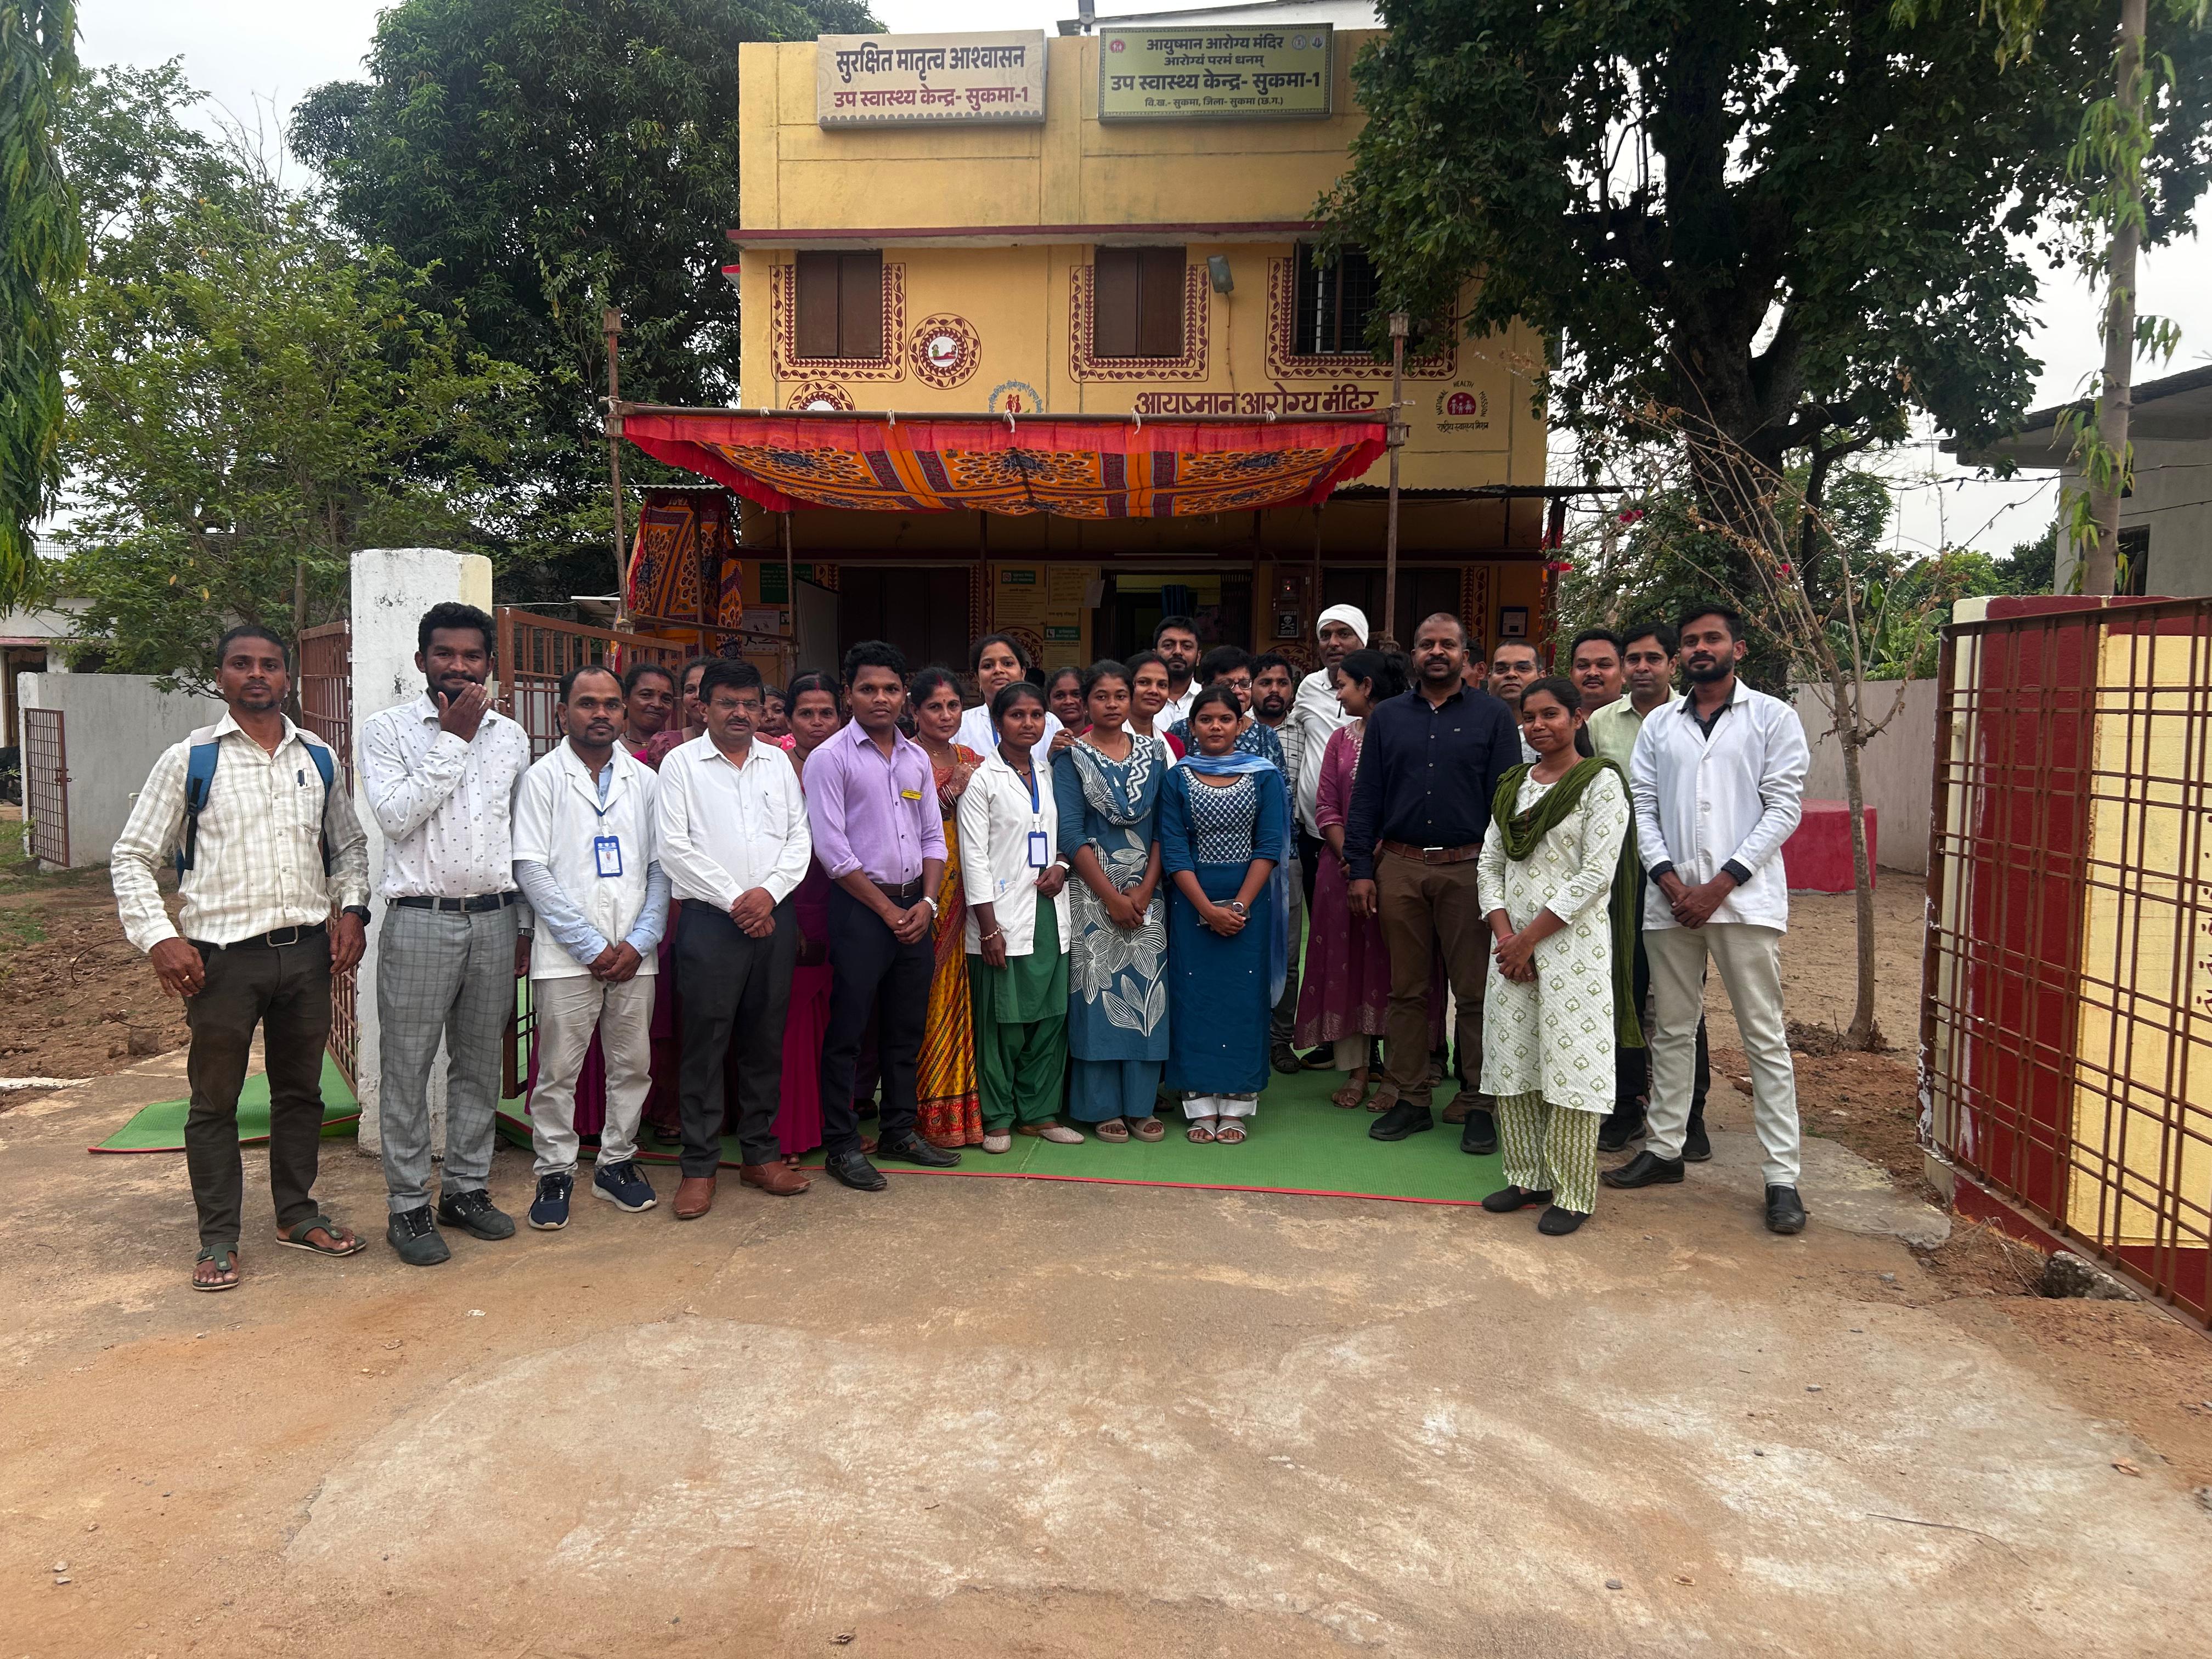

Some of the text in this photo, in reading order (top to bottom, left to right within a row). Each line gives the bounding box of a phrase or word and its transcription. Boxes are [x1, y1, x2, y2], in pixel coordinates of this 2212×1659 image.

[1147, 33, 1284, 55] आयुष्मान आरोग्य मंदिर
[836, 42, 1026, 83] सुरक्षित मातृत्व आश्वासन
[1164, 53, 1265, 68] आरोग्यं परमं धनम्
[1110, 75, 1136, 91] उप
[1138, 74, 1200, 91] स्वास्थ्य
[1252, 72, 1319, 95] सुकमा-1
[834, 91, 857, 107] उप
[860, 89, 917, 106] स्वास्थ्य
[965, 86, 1028, 111] सुकमा-1
[1173, 98, 1201, 109] सुकमा,
[1229, 97, 1255, 108] सुकमा
[1257, 97, 1283, 106] (छ.ग.)
[1453, 380, 1474, 388] HEALTH
[1135, 382, 1379, 415] आयष्मान आरोग्य मंदिर
[1435, 390, 1449, 416] NATIONAL
[1479, 391, 1488, 417] MISSION
